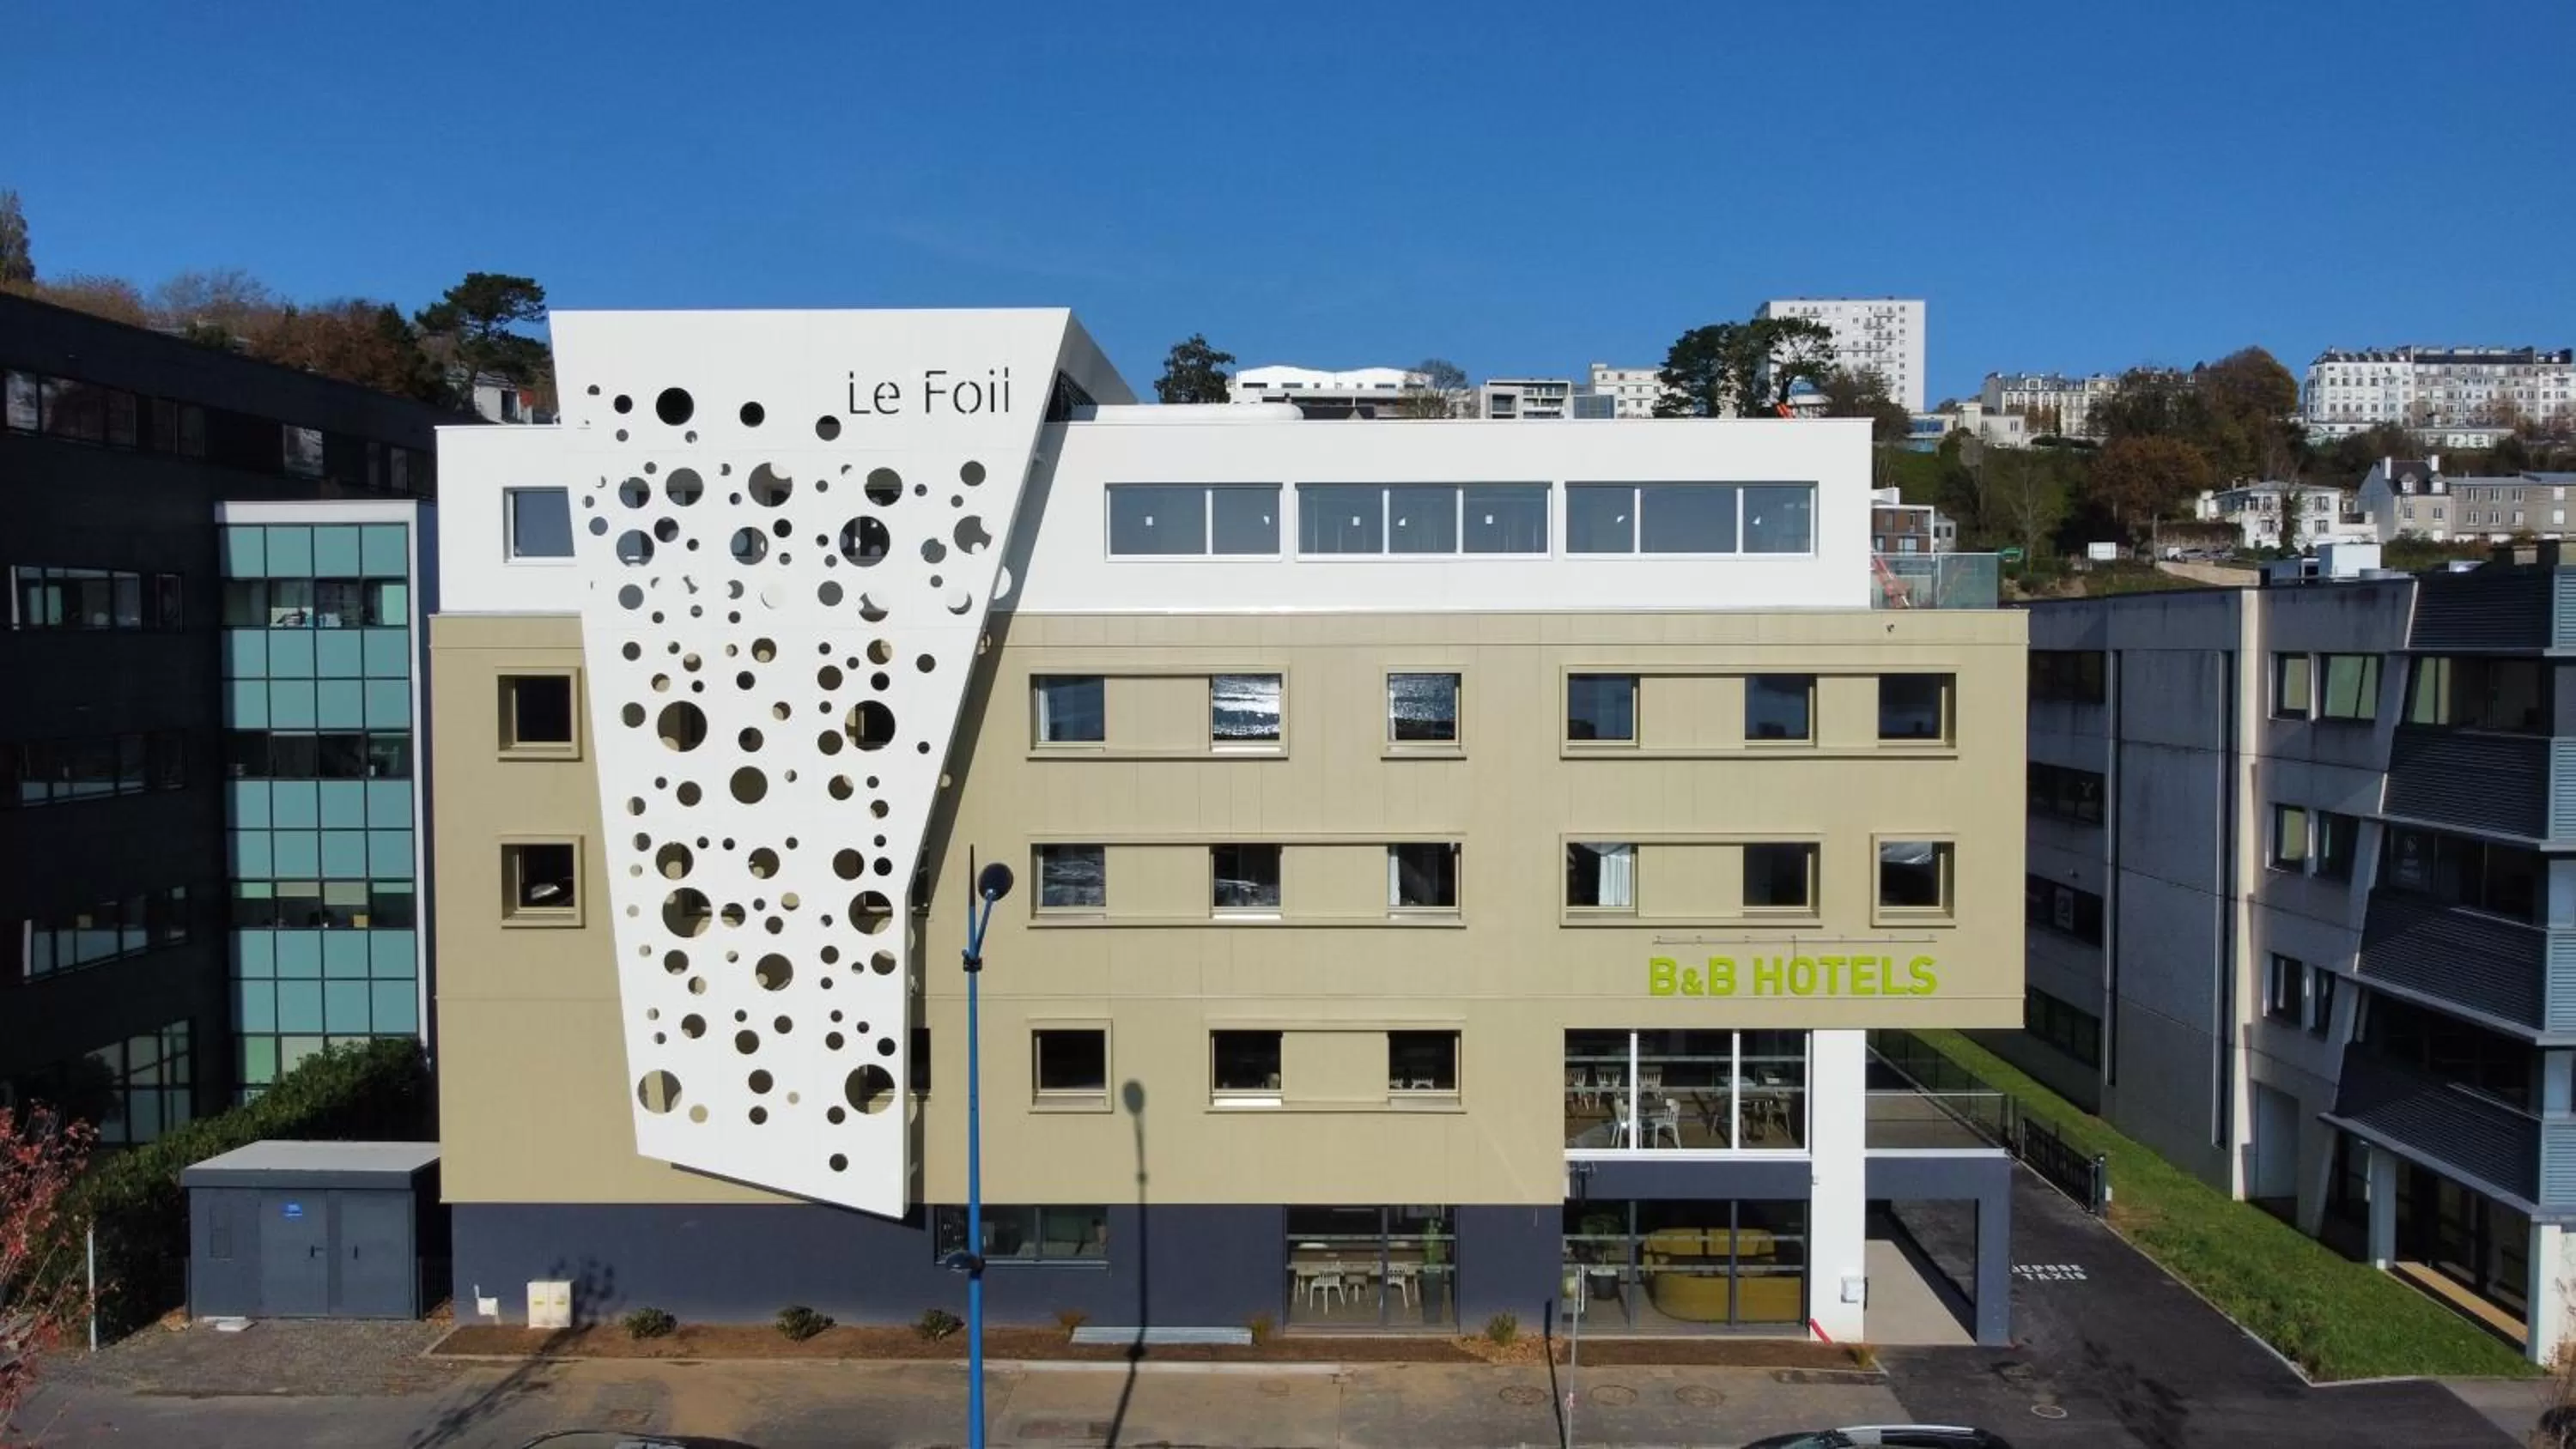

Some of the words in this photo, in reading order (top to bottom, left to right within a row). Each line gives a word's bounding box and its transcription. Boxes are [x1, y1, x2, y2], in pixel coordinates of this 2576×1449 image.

[848, 370, 901, 415] Le
[925, 366, 1009, 415] Foil
[1649, 957, 1737, 997] B&B
[1753, 955, 1938, 997] HOTELS
